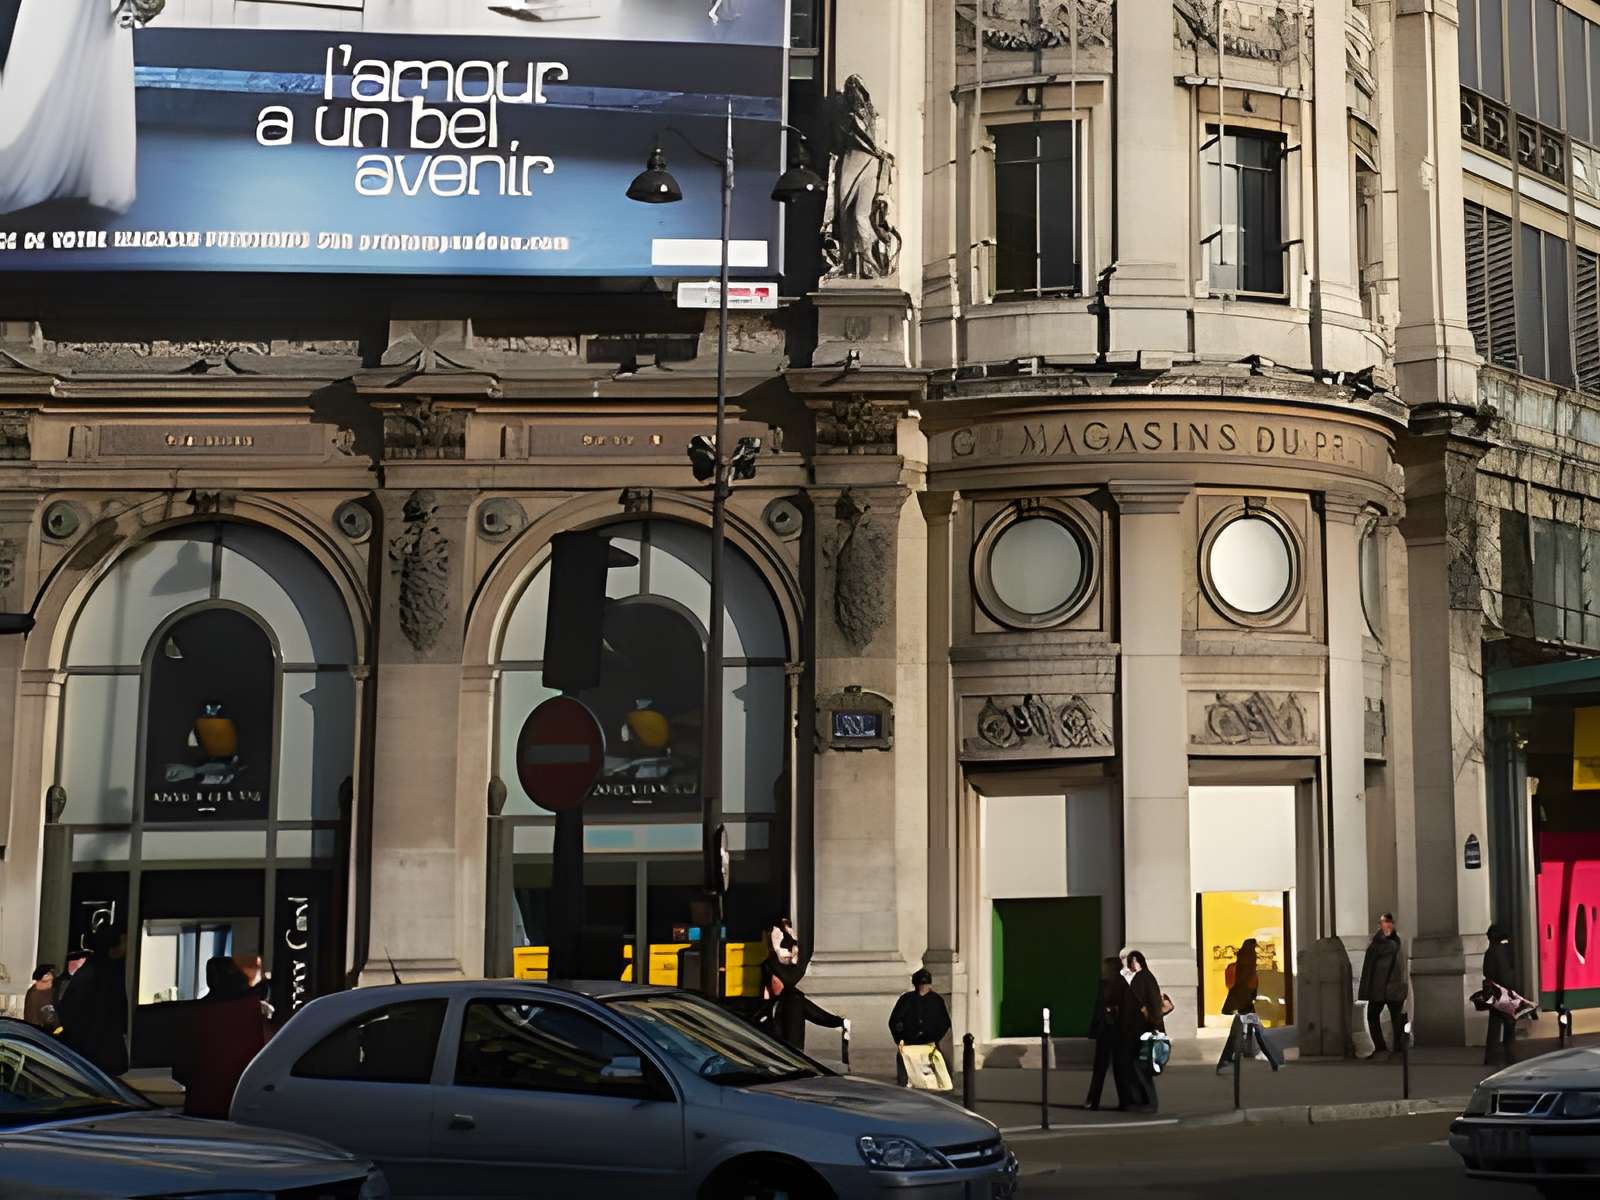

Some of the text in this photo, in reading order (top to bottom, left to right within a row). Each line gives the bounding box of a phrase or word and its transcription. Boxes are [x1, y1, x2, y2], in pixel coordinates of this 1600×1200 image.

[324, 44, 569, 103] l'amour
[256, 94, 498, 148] a un bel
[354, 140, 554, 196] avenir
[1020, 422, 1238, 456] MAGASINS
[1256, 426, 1299, 455] DU
